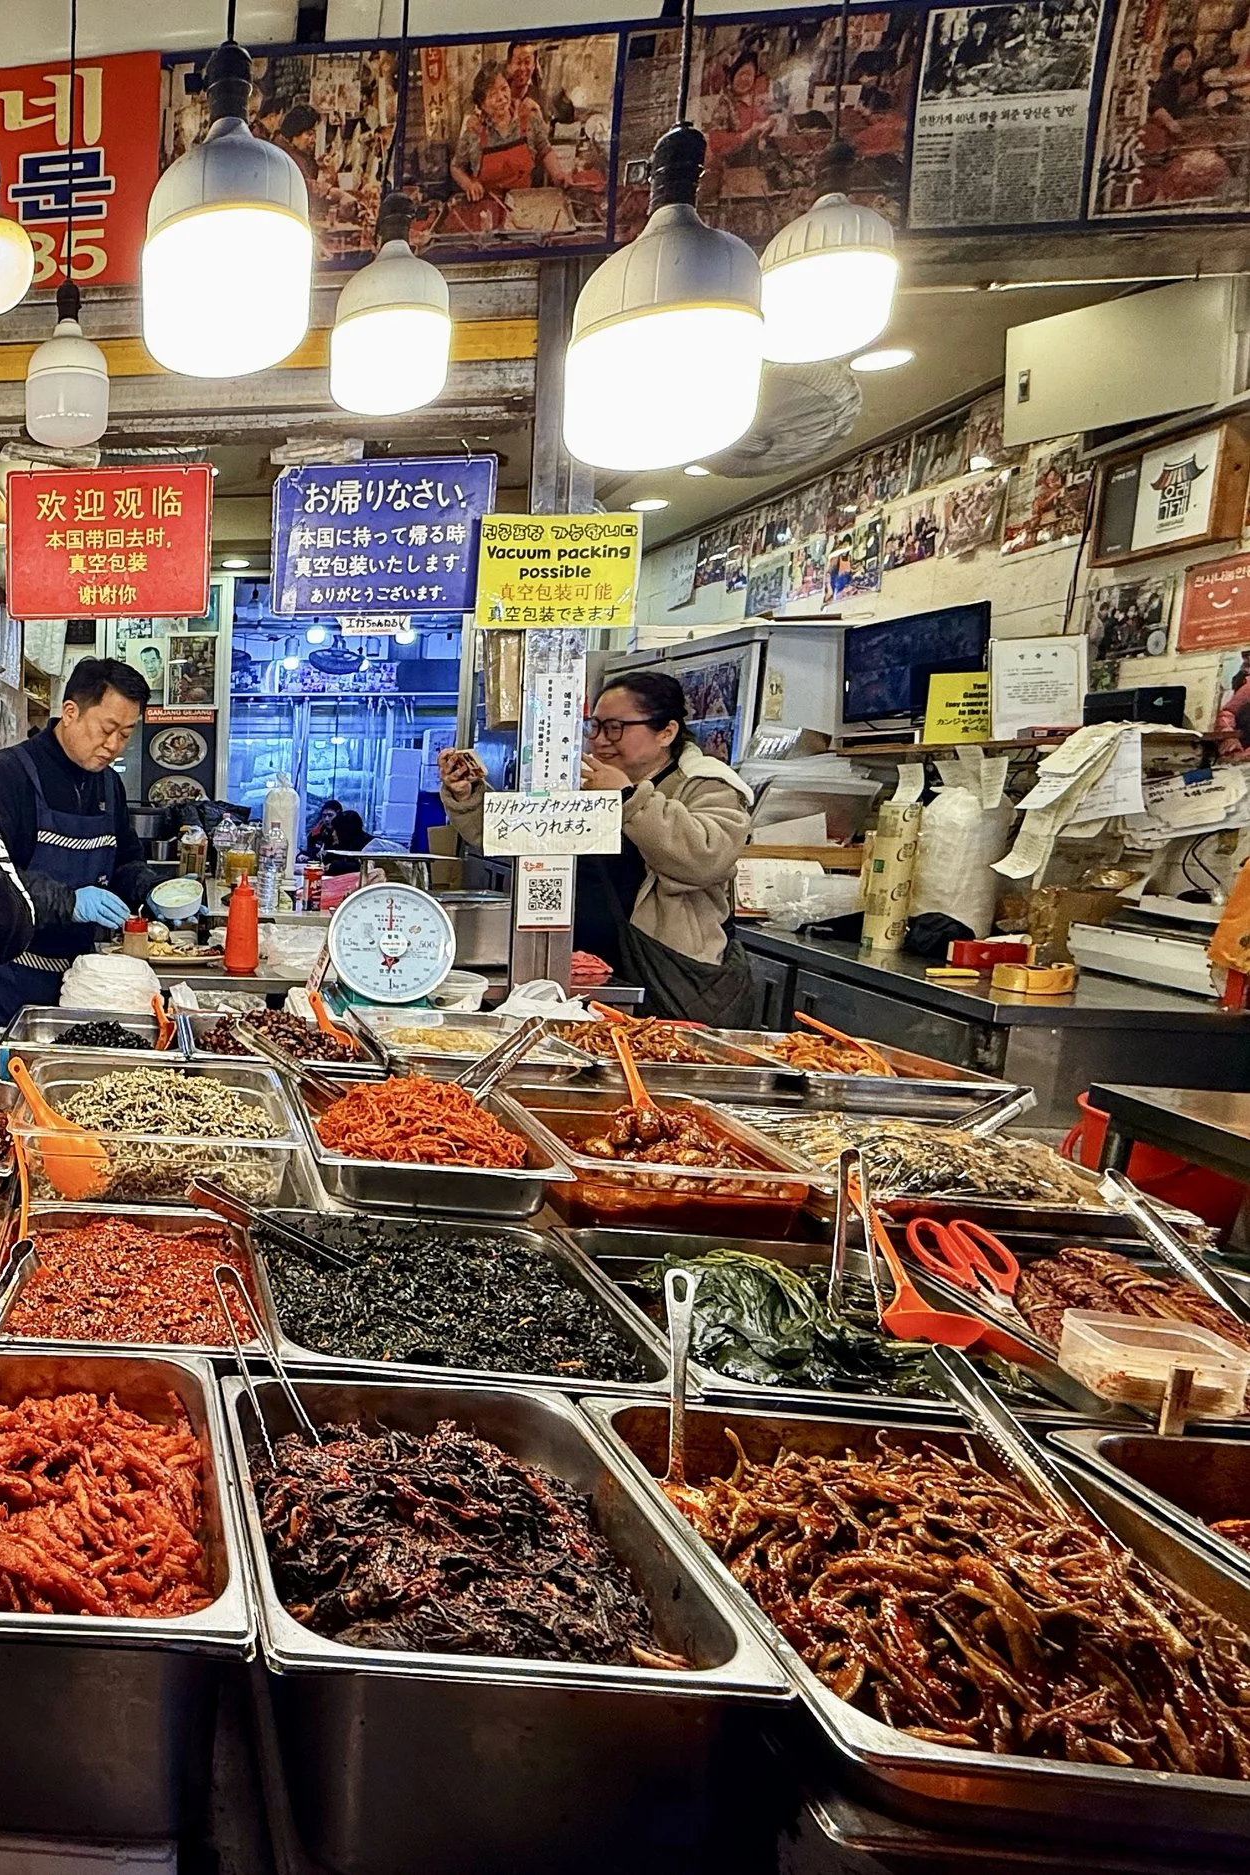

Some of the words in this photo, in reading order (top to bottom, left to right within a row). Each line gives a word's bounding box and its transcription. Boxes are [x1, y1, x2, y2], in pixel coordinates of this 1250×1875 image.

[36, 485, 184, 523] 欢迎观临
[298, 523, 467, 549] 本国に持って帰る時
[482, 523, 544, 542] 진공포장
[551, 523, 639, 542] 가능합니다
[487, 545, 551, 559] Vacuum
[557, 544, 631, 561] packing
[67, 552, 148, 575] 真空包装
[519, 565, 591, 580] possible
[78, 584, 137, 606] 谢谢你
[500, 583, 613, 601] 真空包装可能
[488, 605, 620, 622] 真空包装できます
